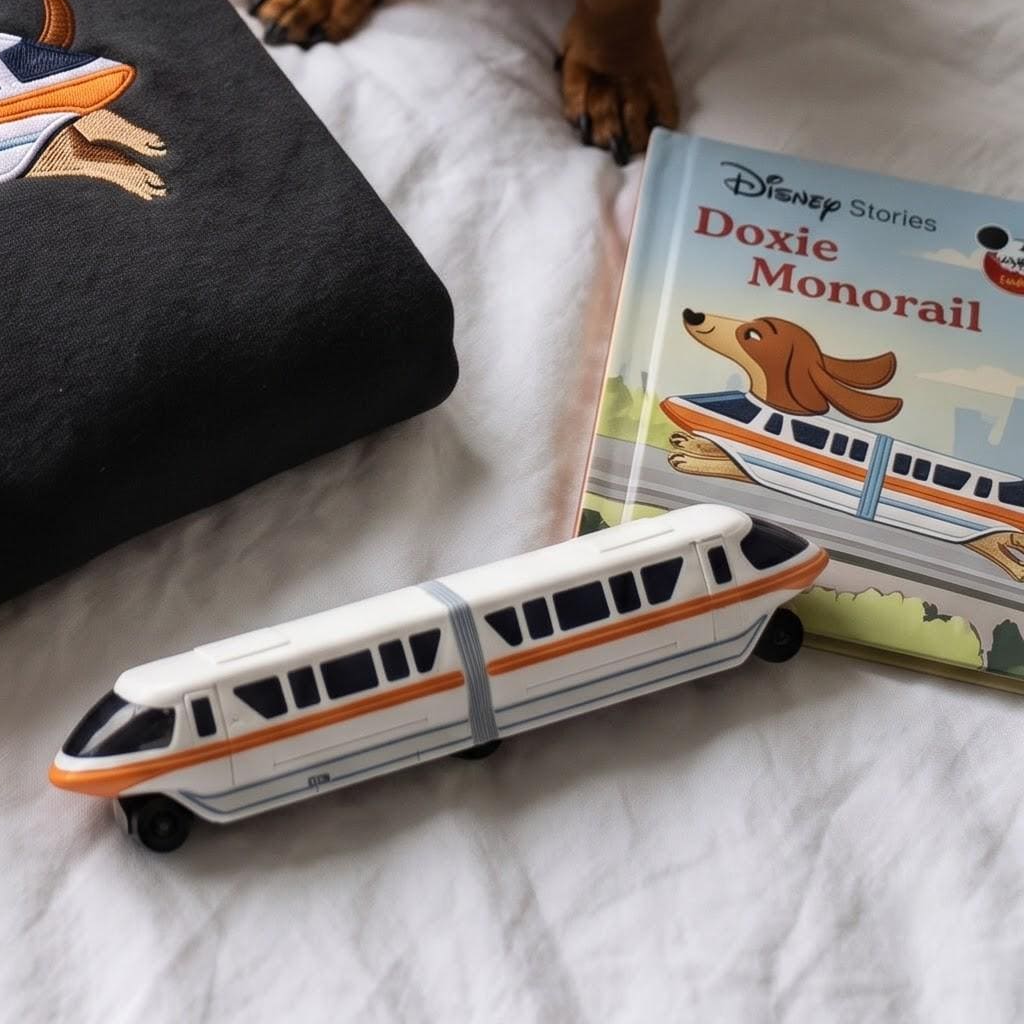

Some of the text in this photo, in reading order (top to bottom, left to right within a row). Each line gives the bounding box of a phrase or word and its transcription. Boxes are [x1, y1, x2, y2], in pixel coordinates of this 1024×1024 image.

[720, 161, 938, 233] Disney Stories
[693, 205, 840, 263] Doxie
[747, 256, 983, 333] Monorail
